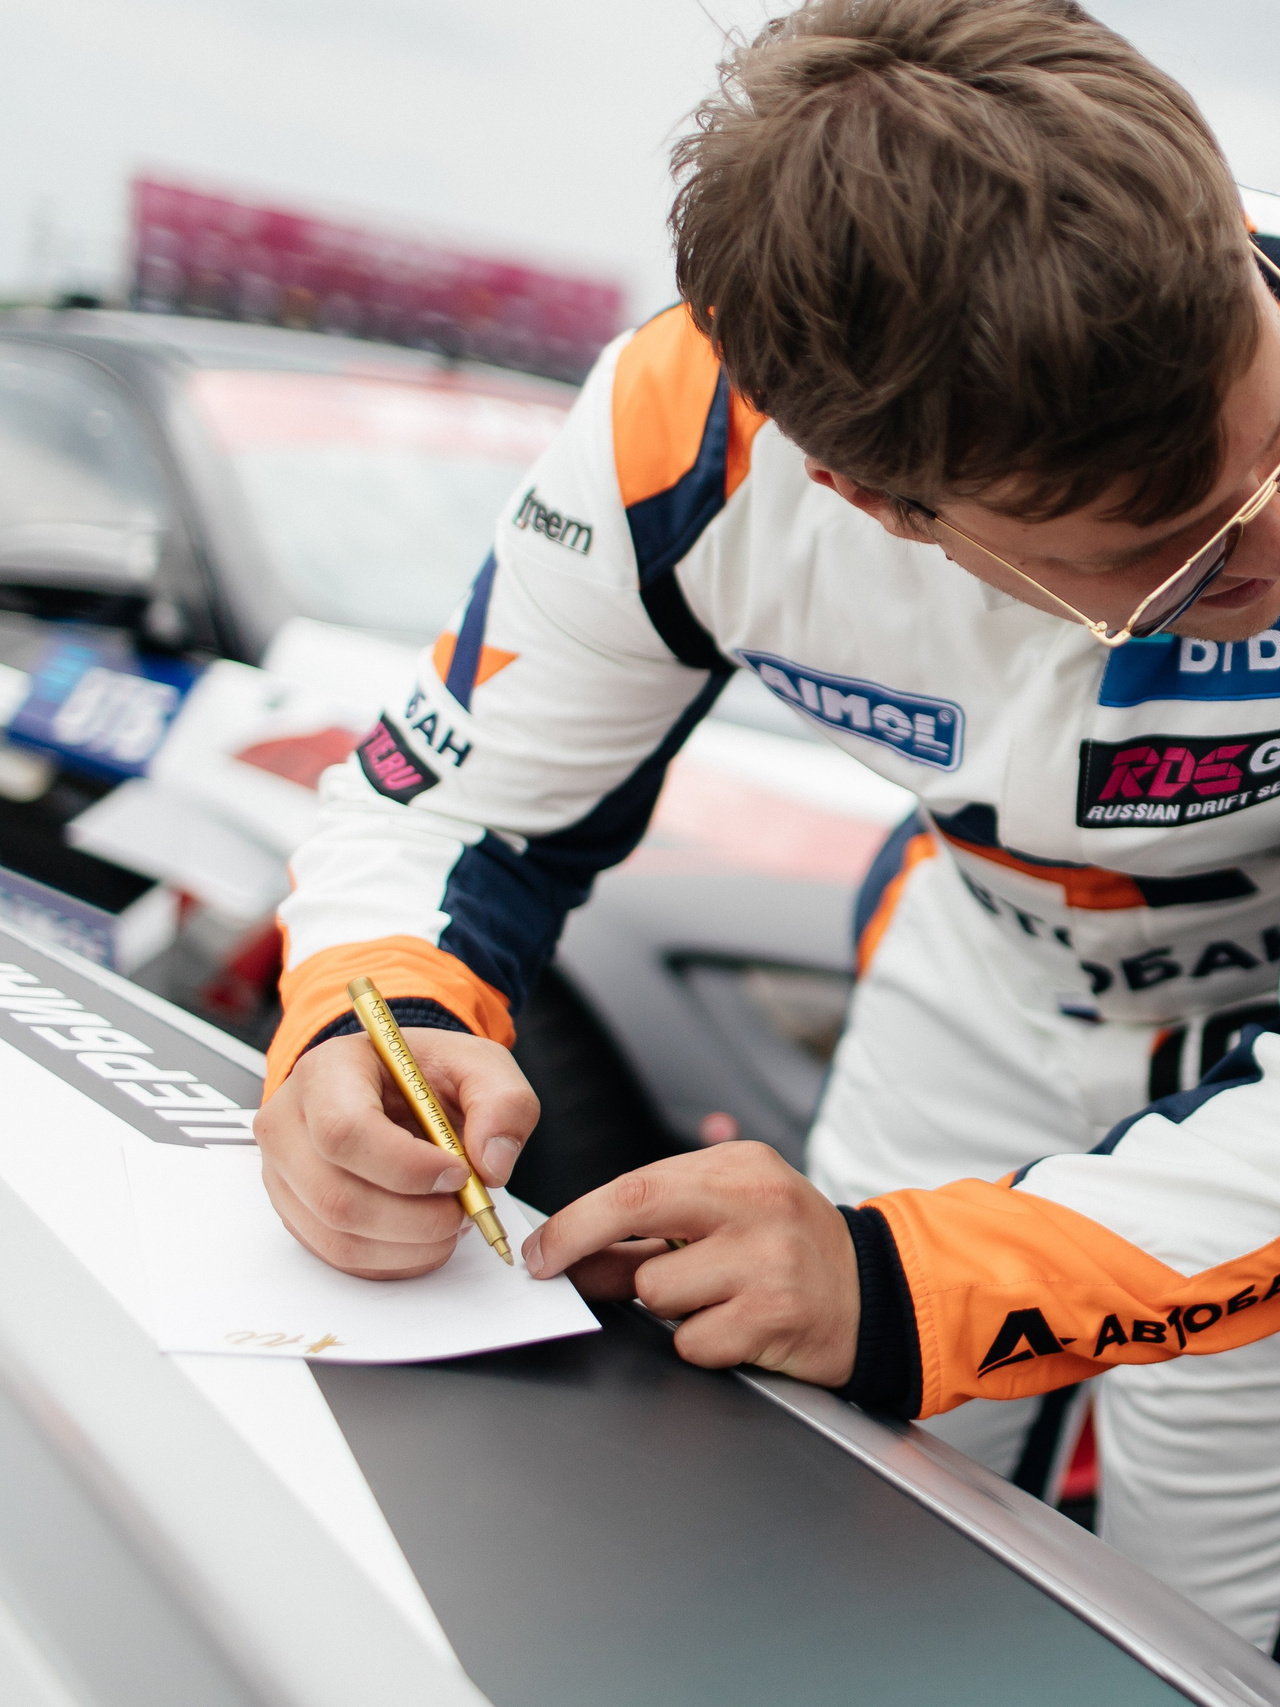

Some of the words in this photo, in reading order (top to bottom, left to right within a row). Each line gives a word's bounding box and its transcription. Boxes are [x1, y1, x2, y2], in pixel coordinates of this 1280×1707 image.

[759, 661, 950, 760] AIMOL
[1099, 744, 1250, 801] RDS
[1086, 802, 1181, 821] RUSSIAN
[1185, 790, 1253, 819] DRIFT
[369, 999, 392, 1031] PEN
[427, 1101, 459, 1150] Metallic
